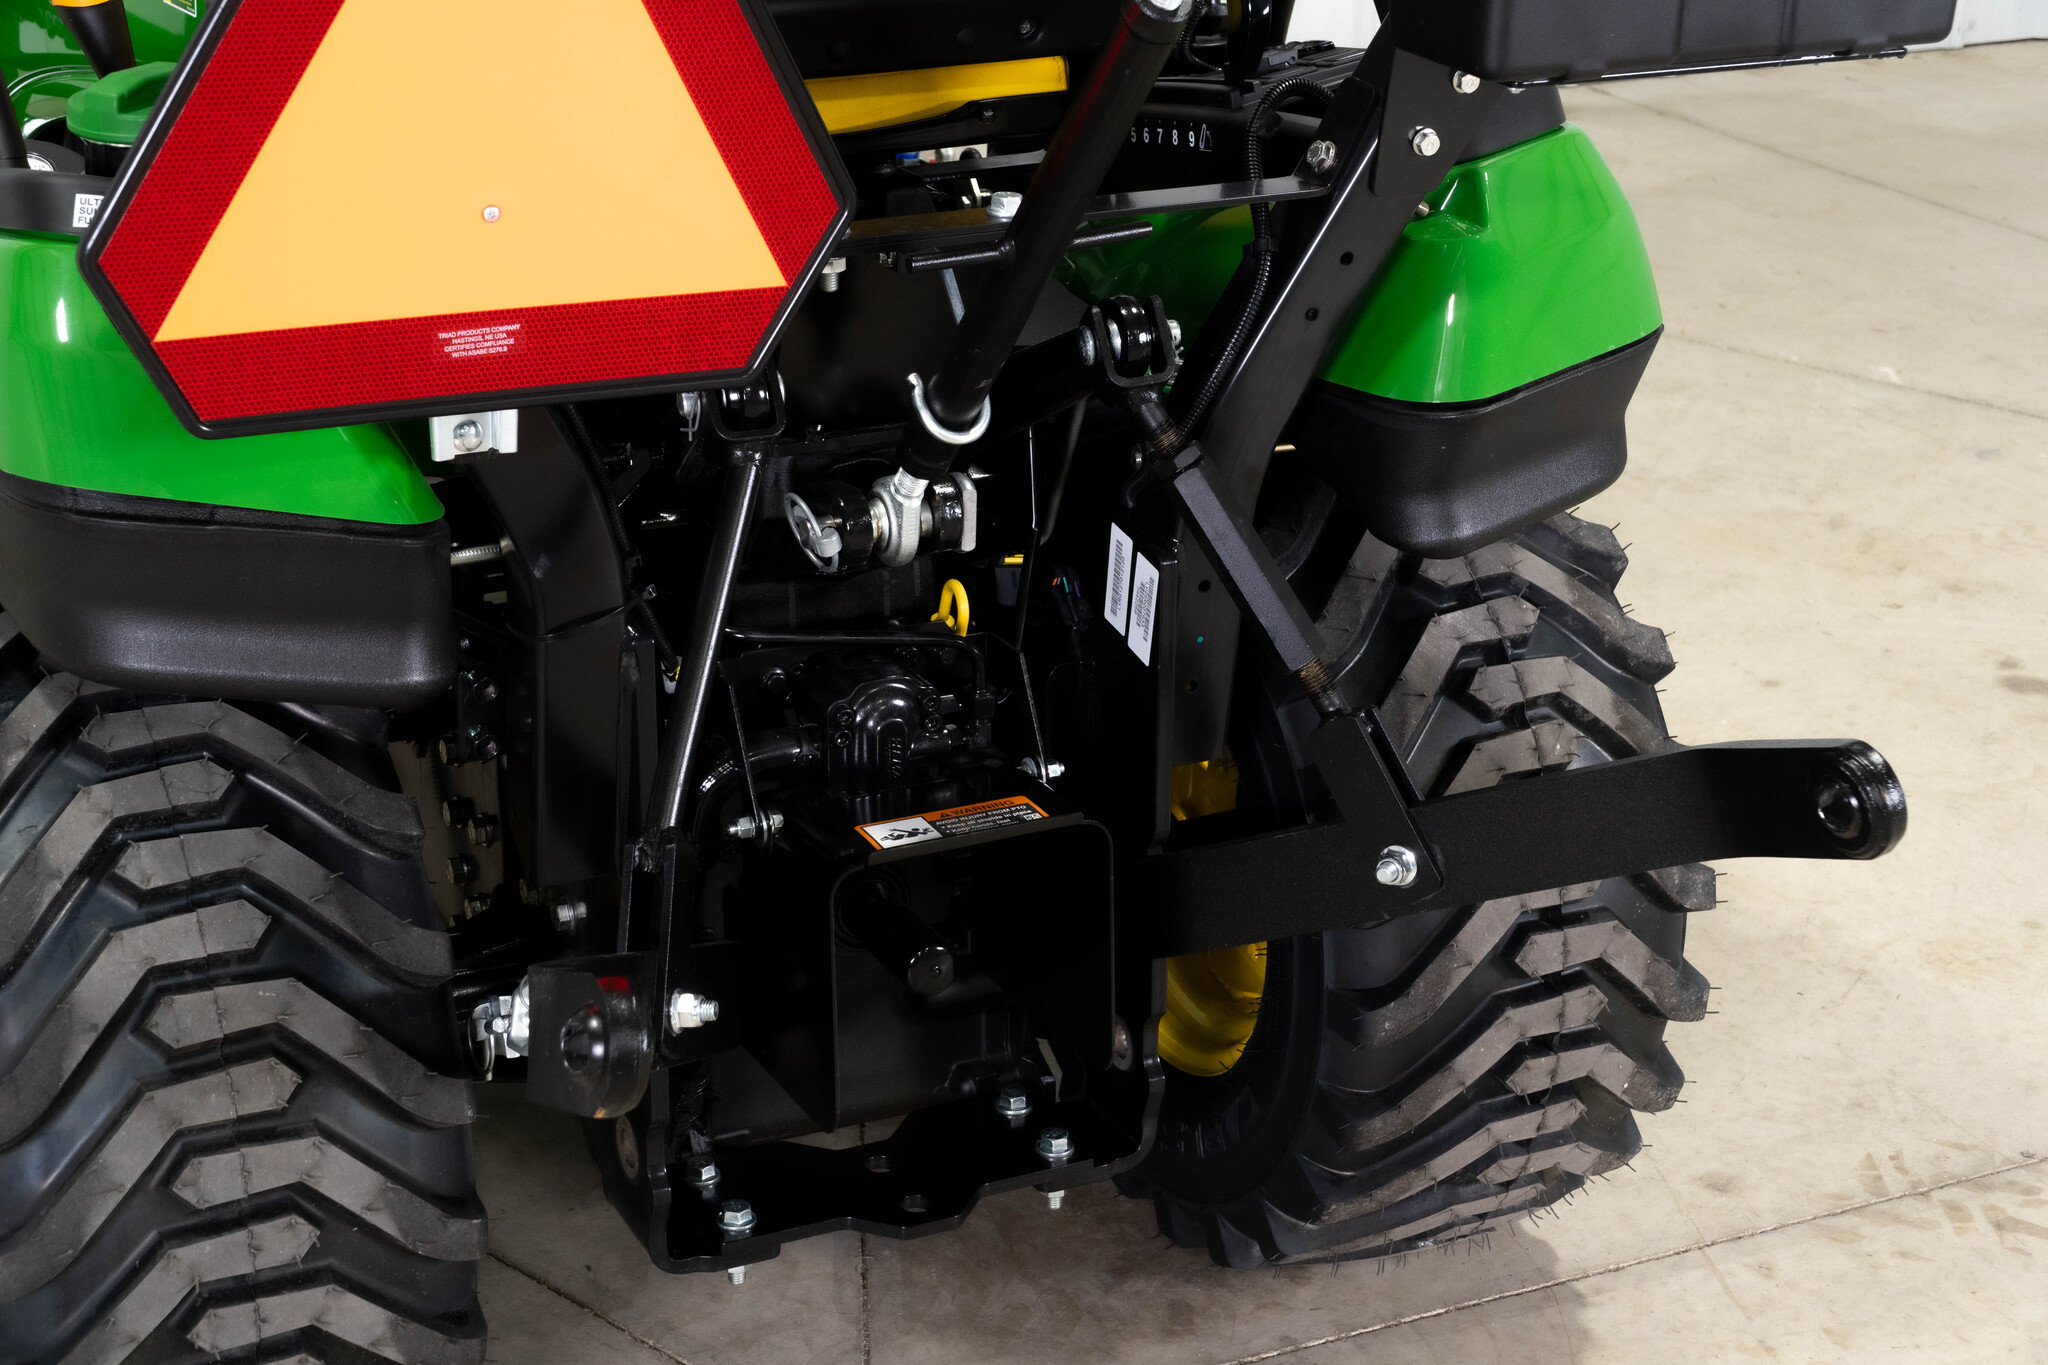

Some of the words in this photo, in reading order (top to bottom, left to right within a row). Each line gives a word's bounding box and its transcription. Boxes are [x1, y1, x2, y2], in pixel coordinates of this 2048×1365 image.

[1131, 127, 1137, 142] 5
[1144, 127, 1150, 143] 6
[1157, 128, 1163, 144] 7
[1172, 129, 1179, 146] 8
[1188, 131, 1195, 147] 9
[79, 198, 101, 206] ULT
[79, 207, 94, 215] SU
[77, 216, 91, 224] FU
[438, 331, 457, 339] TRIAD
[457, 327, 490, 336] PRODUCTS
[490, 324, 520, 333] COMPANY
[494, 332, 508, 340] USA
[444, 342, 476, 352] CERTIFIES
[476, 338, 515, 349] COMPLIANCE
[451, 350, 468, 358] WITH
[951, 800, 1015, 815] WARNING
[936, 817, 959, 826] AVOID
[959, 812, 987, 822] INJURY
[987, 807, 1011, 816] FROM
[977, 815, 1004, 823] shields
[1012, 809, 1032, 817] place
